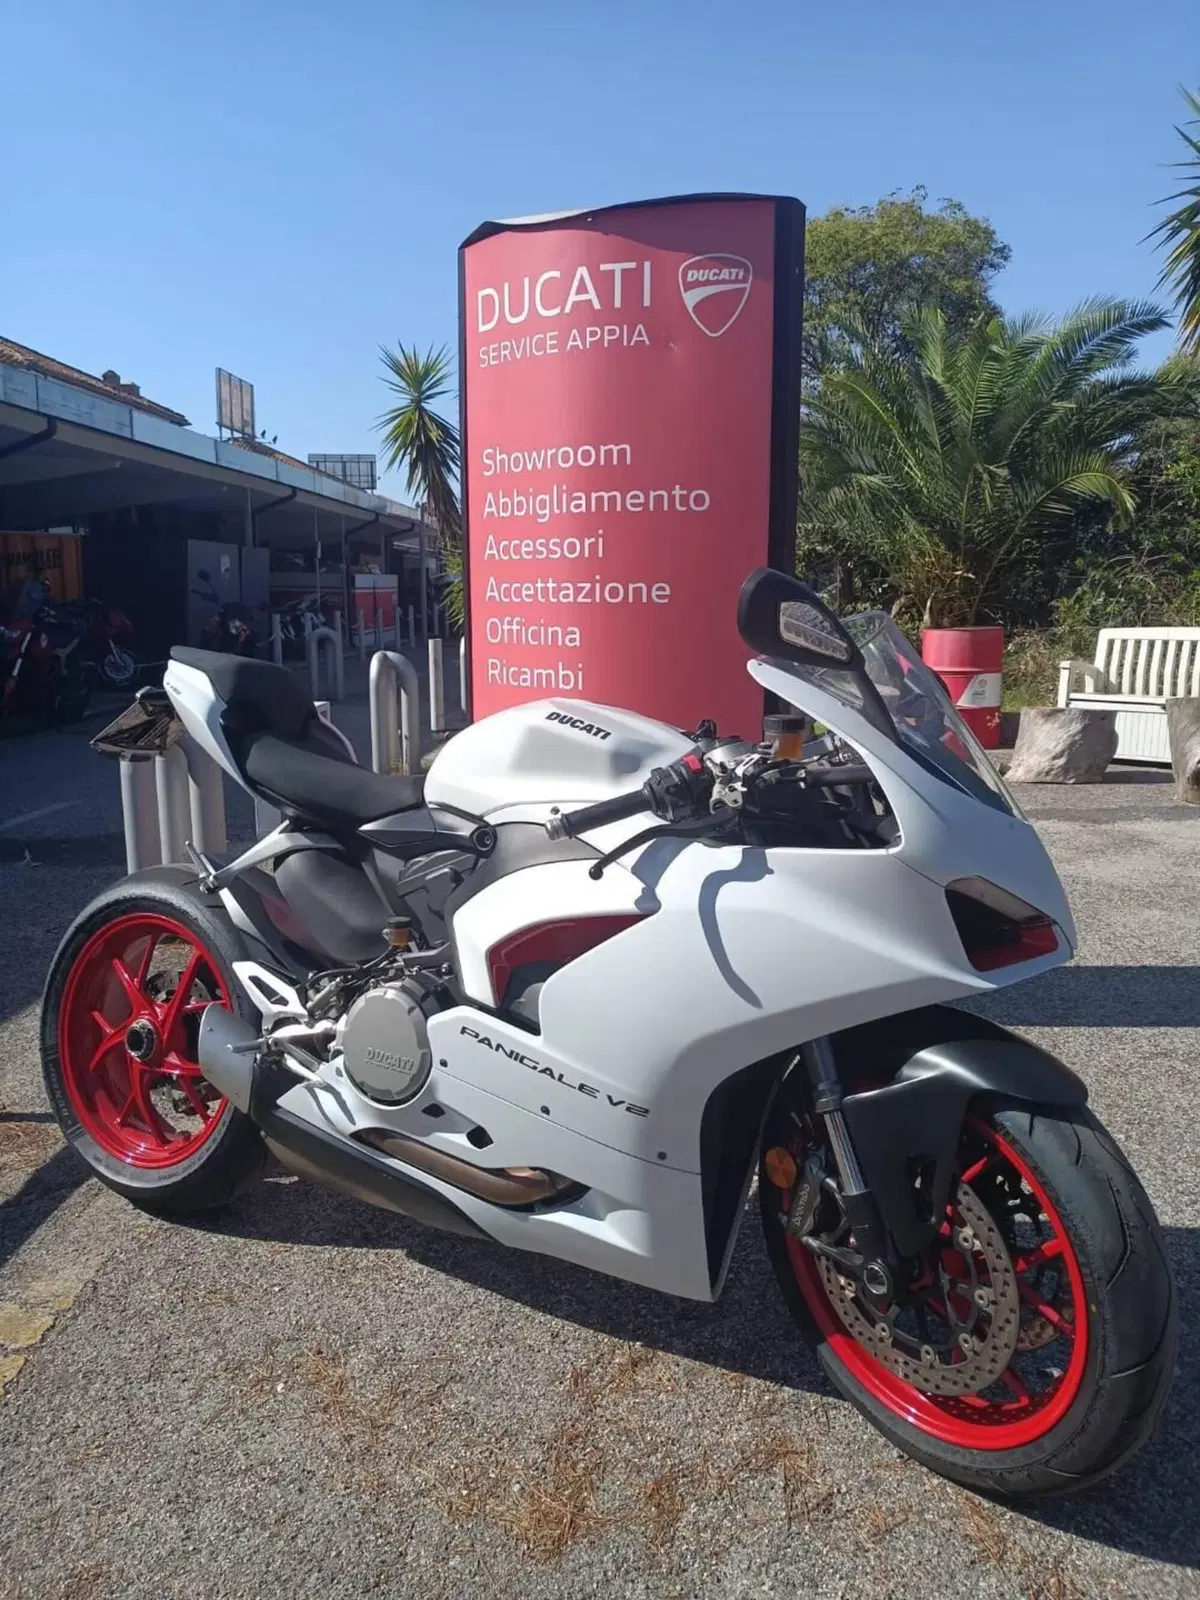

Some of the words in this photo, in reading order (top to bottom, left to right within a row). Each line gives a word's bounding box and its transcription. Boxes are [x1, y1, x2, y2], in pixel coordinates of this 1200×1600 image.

[687, 268, 744, 282] DUCATI
[477, 261, 651, 333] DUCATI
[479, 331, 559, 368] SERVICE
[566, 324, 650, 351] APPIA
[482, 443, 631, 476] Showroom
[483, 485, 710, 523] Abbigliamento
[484, 530, 604, 560] Accessori
[485, 575, 671, 603] Accettazione
[486, 617, 581, 647] Officina
[487, 658, 583, 690] Ricambi
[545, 711, 612, 740] DUCATI
[364, 1047, 414, 1072] DUCATI
[460, 1026, 600, 1098] PANIGALE
[606, 1094, 650, 1117] V2
[792, 1183, 810, 1226] brembo
